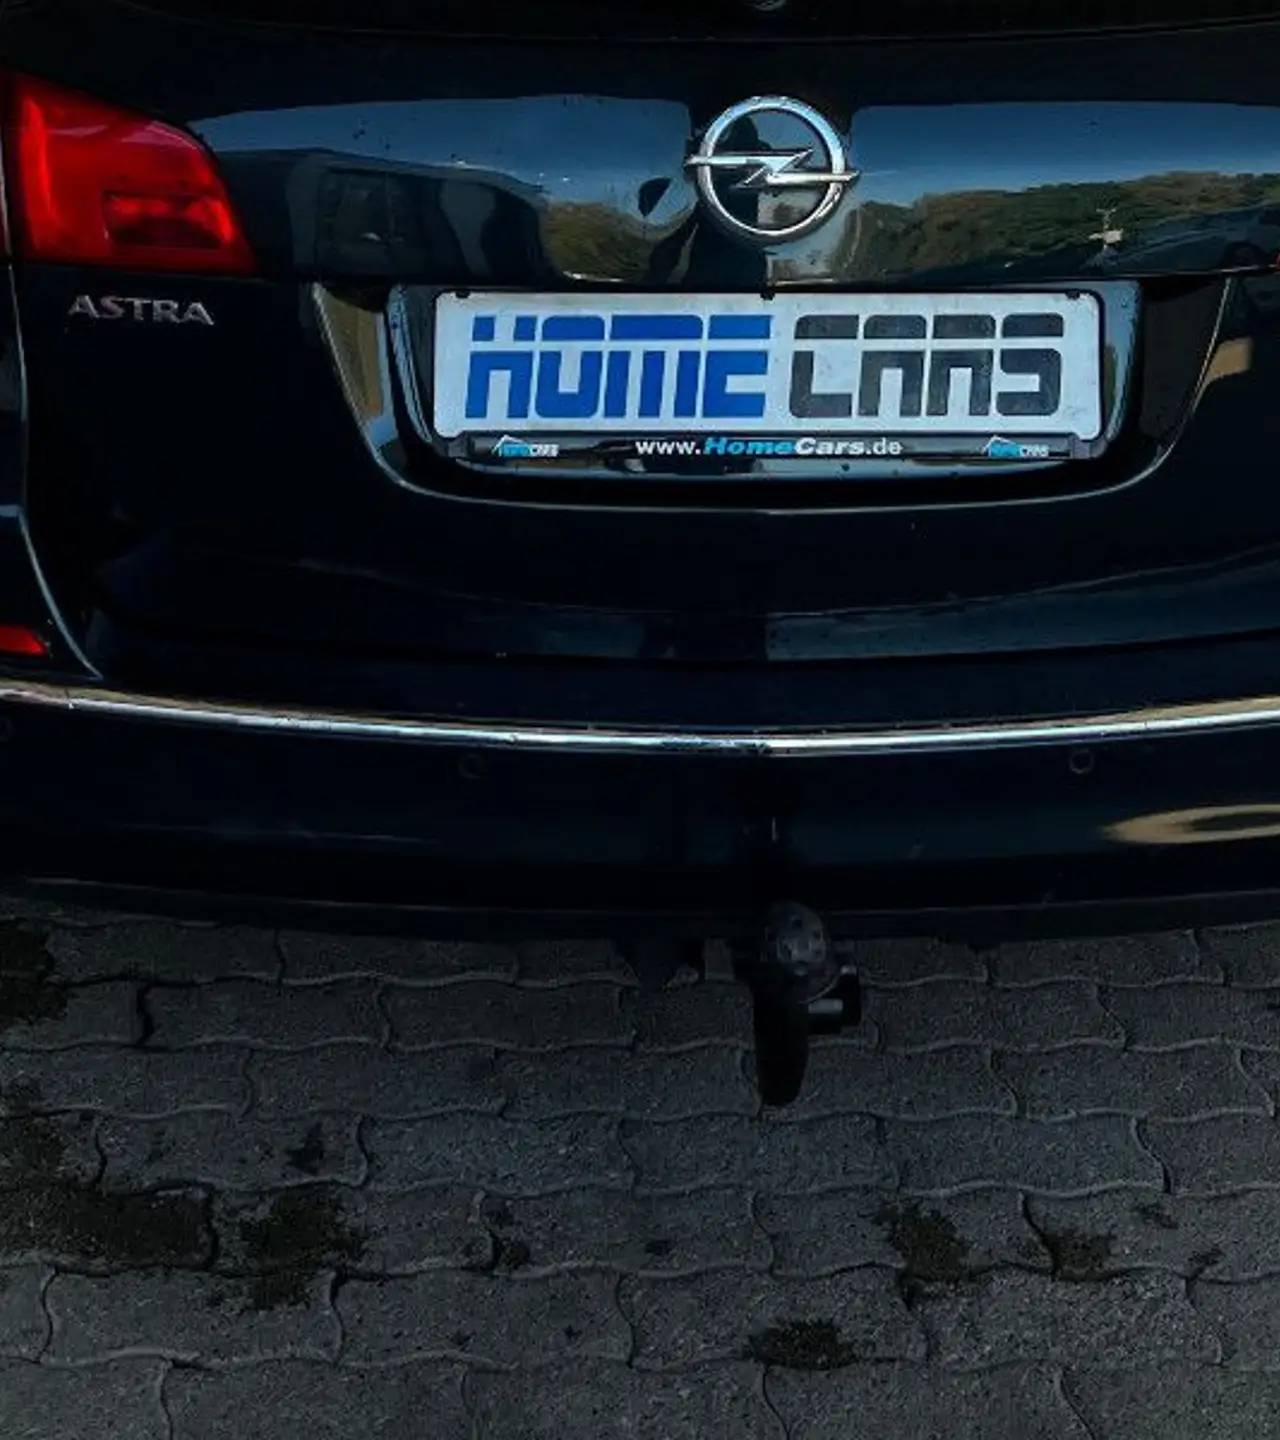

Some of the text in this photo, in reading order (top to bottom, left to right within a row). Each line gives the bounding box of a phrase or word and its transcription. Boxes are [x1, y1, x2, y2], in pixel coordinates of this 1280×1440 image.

[69, 294, 214, 326] ASTRA
[464, 312, 1066, 419] HOME CARS
[634, 436, 904, 456] www.HomeCars.de
